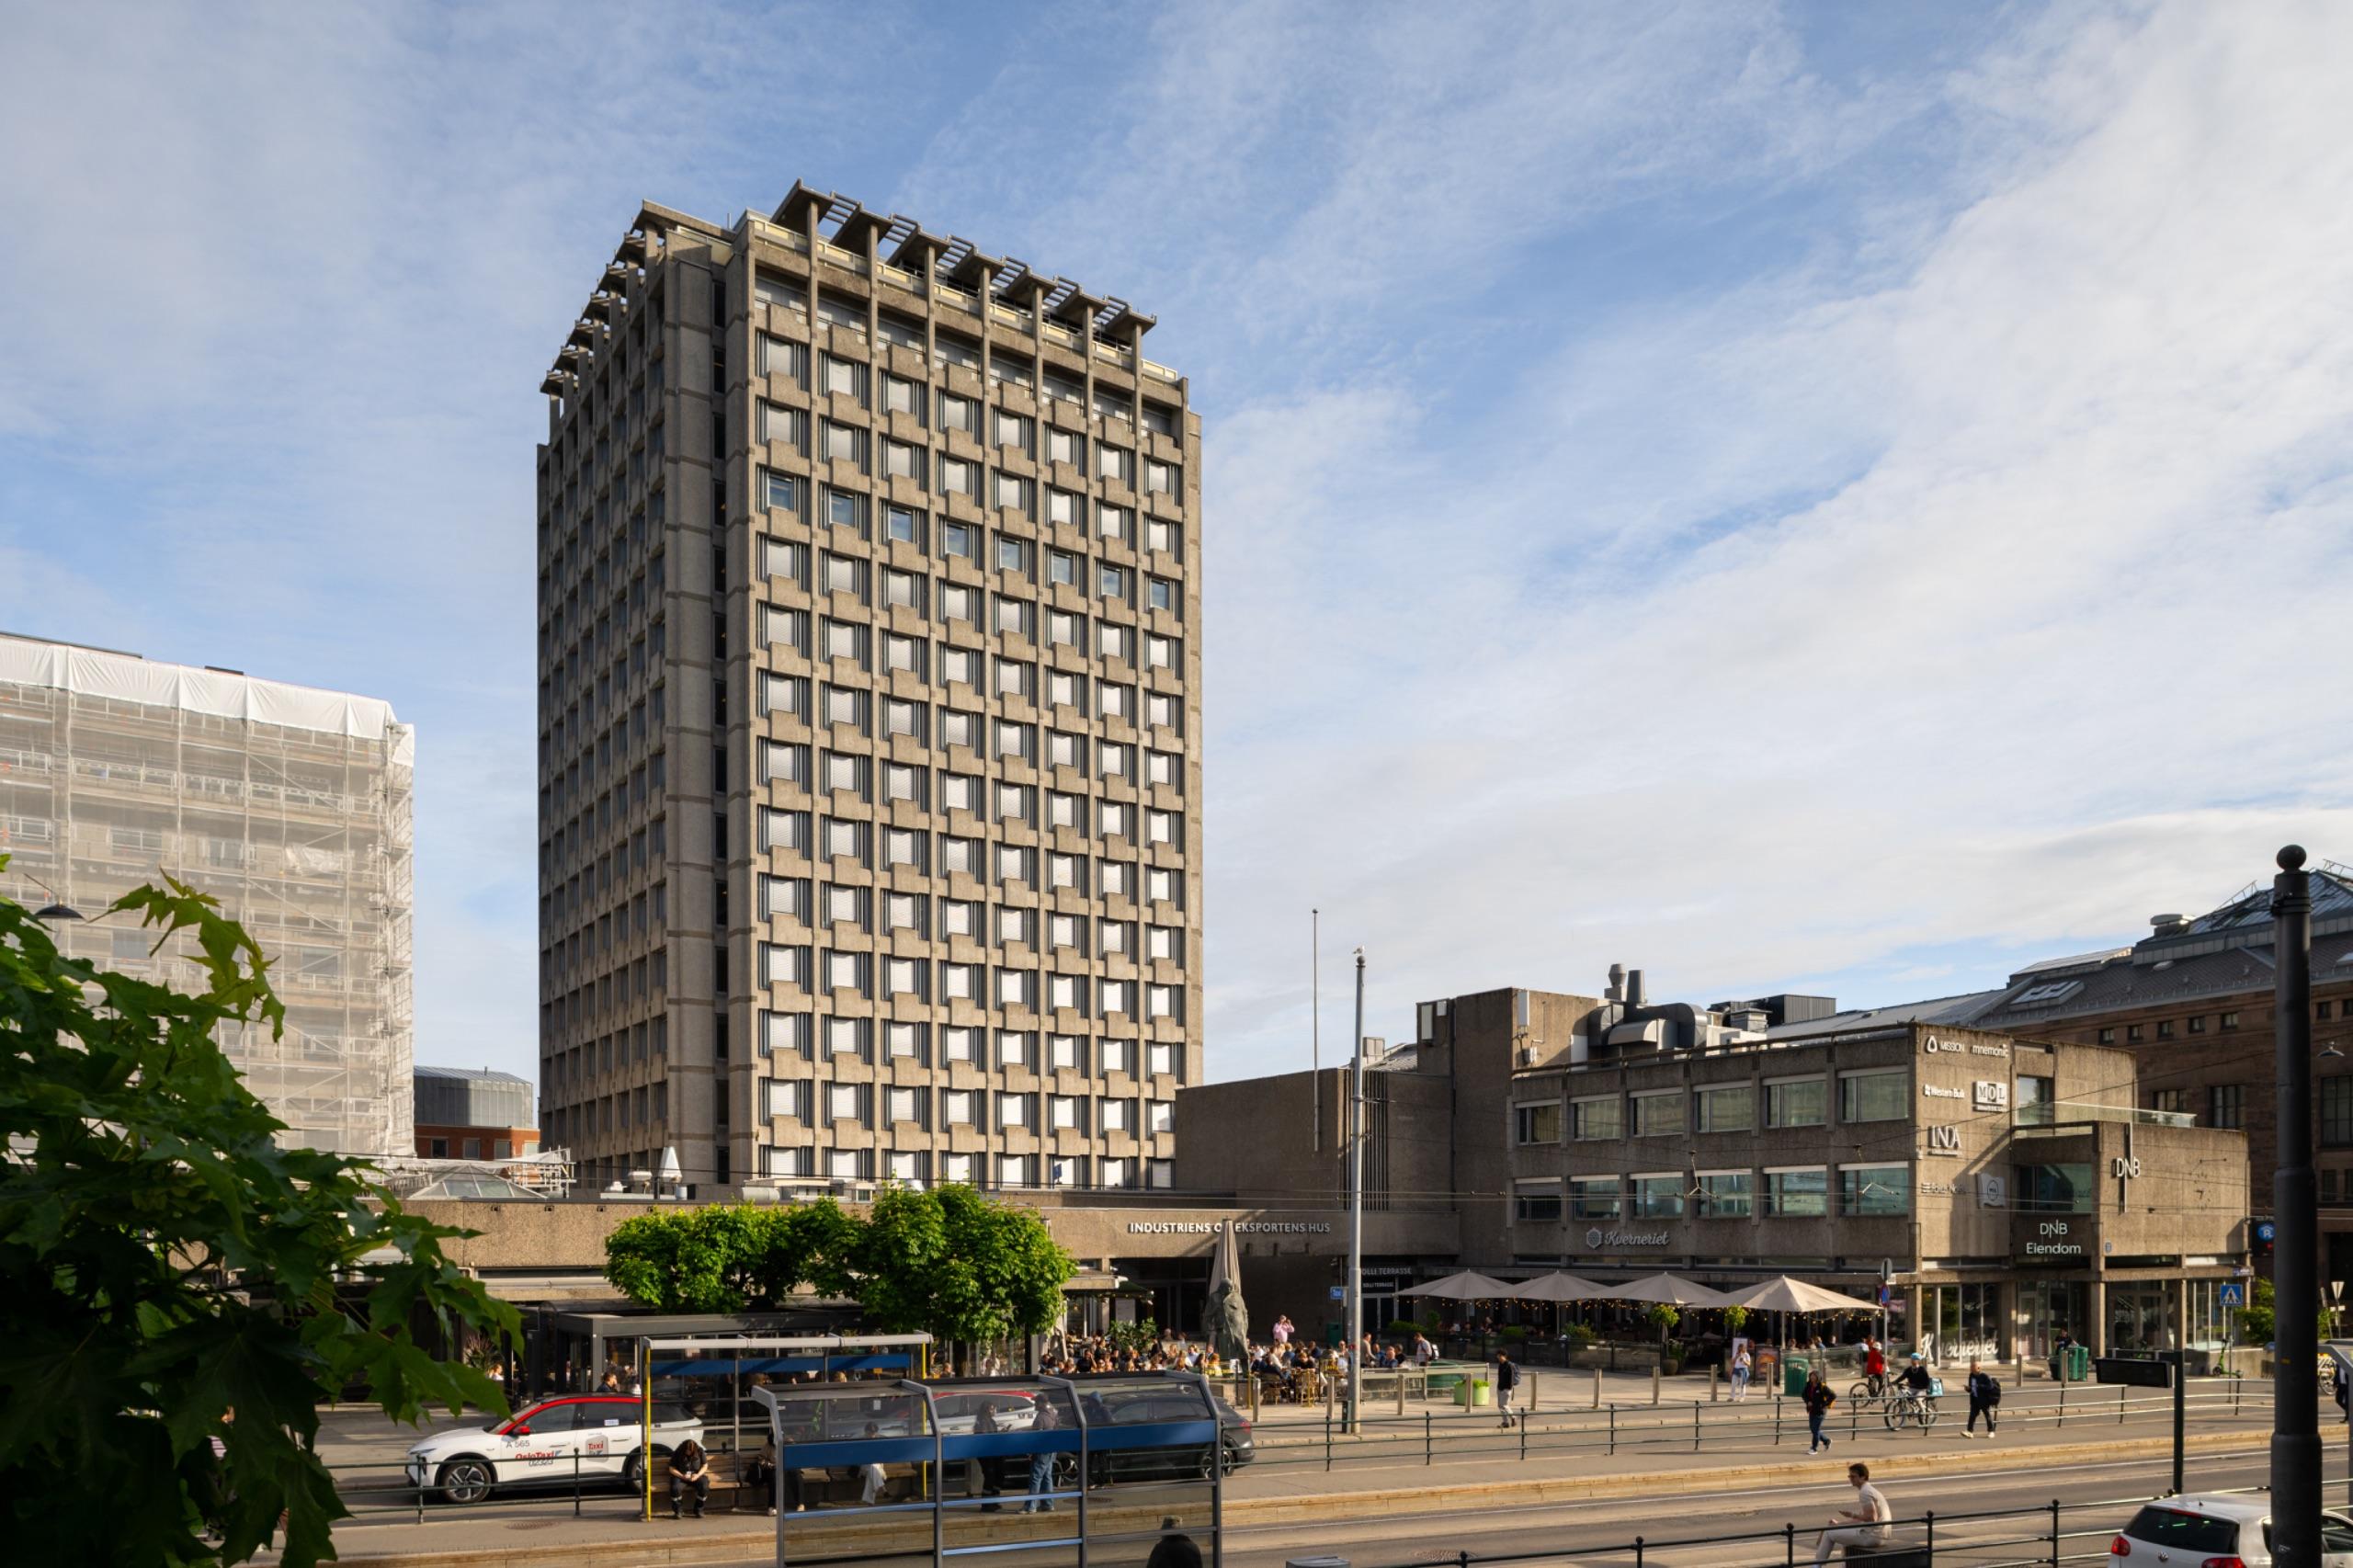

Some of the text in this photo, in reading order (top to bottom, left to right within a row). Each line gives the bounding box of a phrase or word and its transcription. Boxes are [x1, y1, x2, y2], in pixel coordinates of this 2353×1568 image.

[1940, 1040, 1965, 1052] MISSION
[1972, 1043, 2008, 1058] mnemonic
[1978, 1084, 2006, 1101] MOL
[1130, 1222, 1330, 1233] INDUSTRIENS O EKSPORTENS HUS
[2040, 1219, 2068, 1238] DNB
[1604, 1231, 1670, 1246] Kverneriet
[2026, 1243, 2082, 1255] Eiendom
[1361, 1267, 1412, 1277] OLLI TERRASSE
[506, 1439, 530, 1449] A 565
[588, 1440, 604, 1450] Taxi
